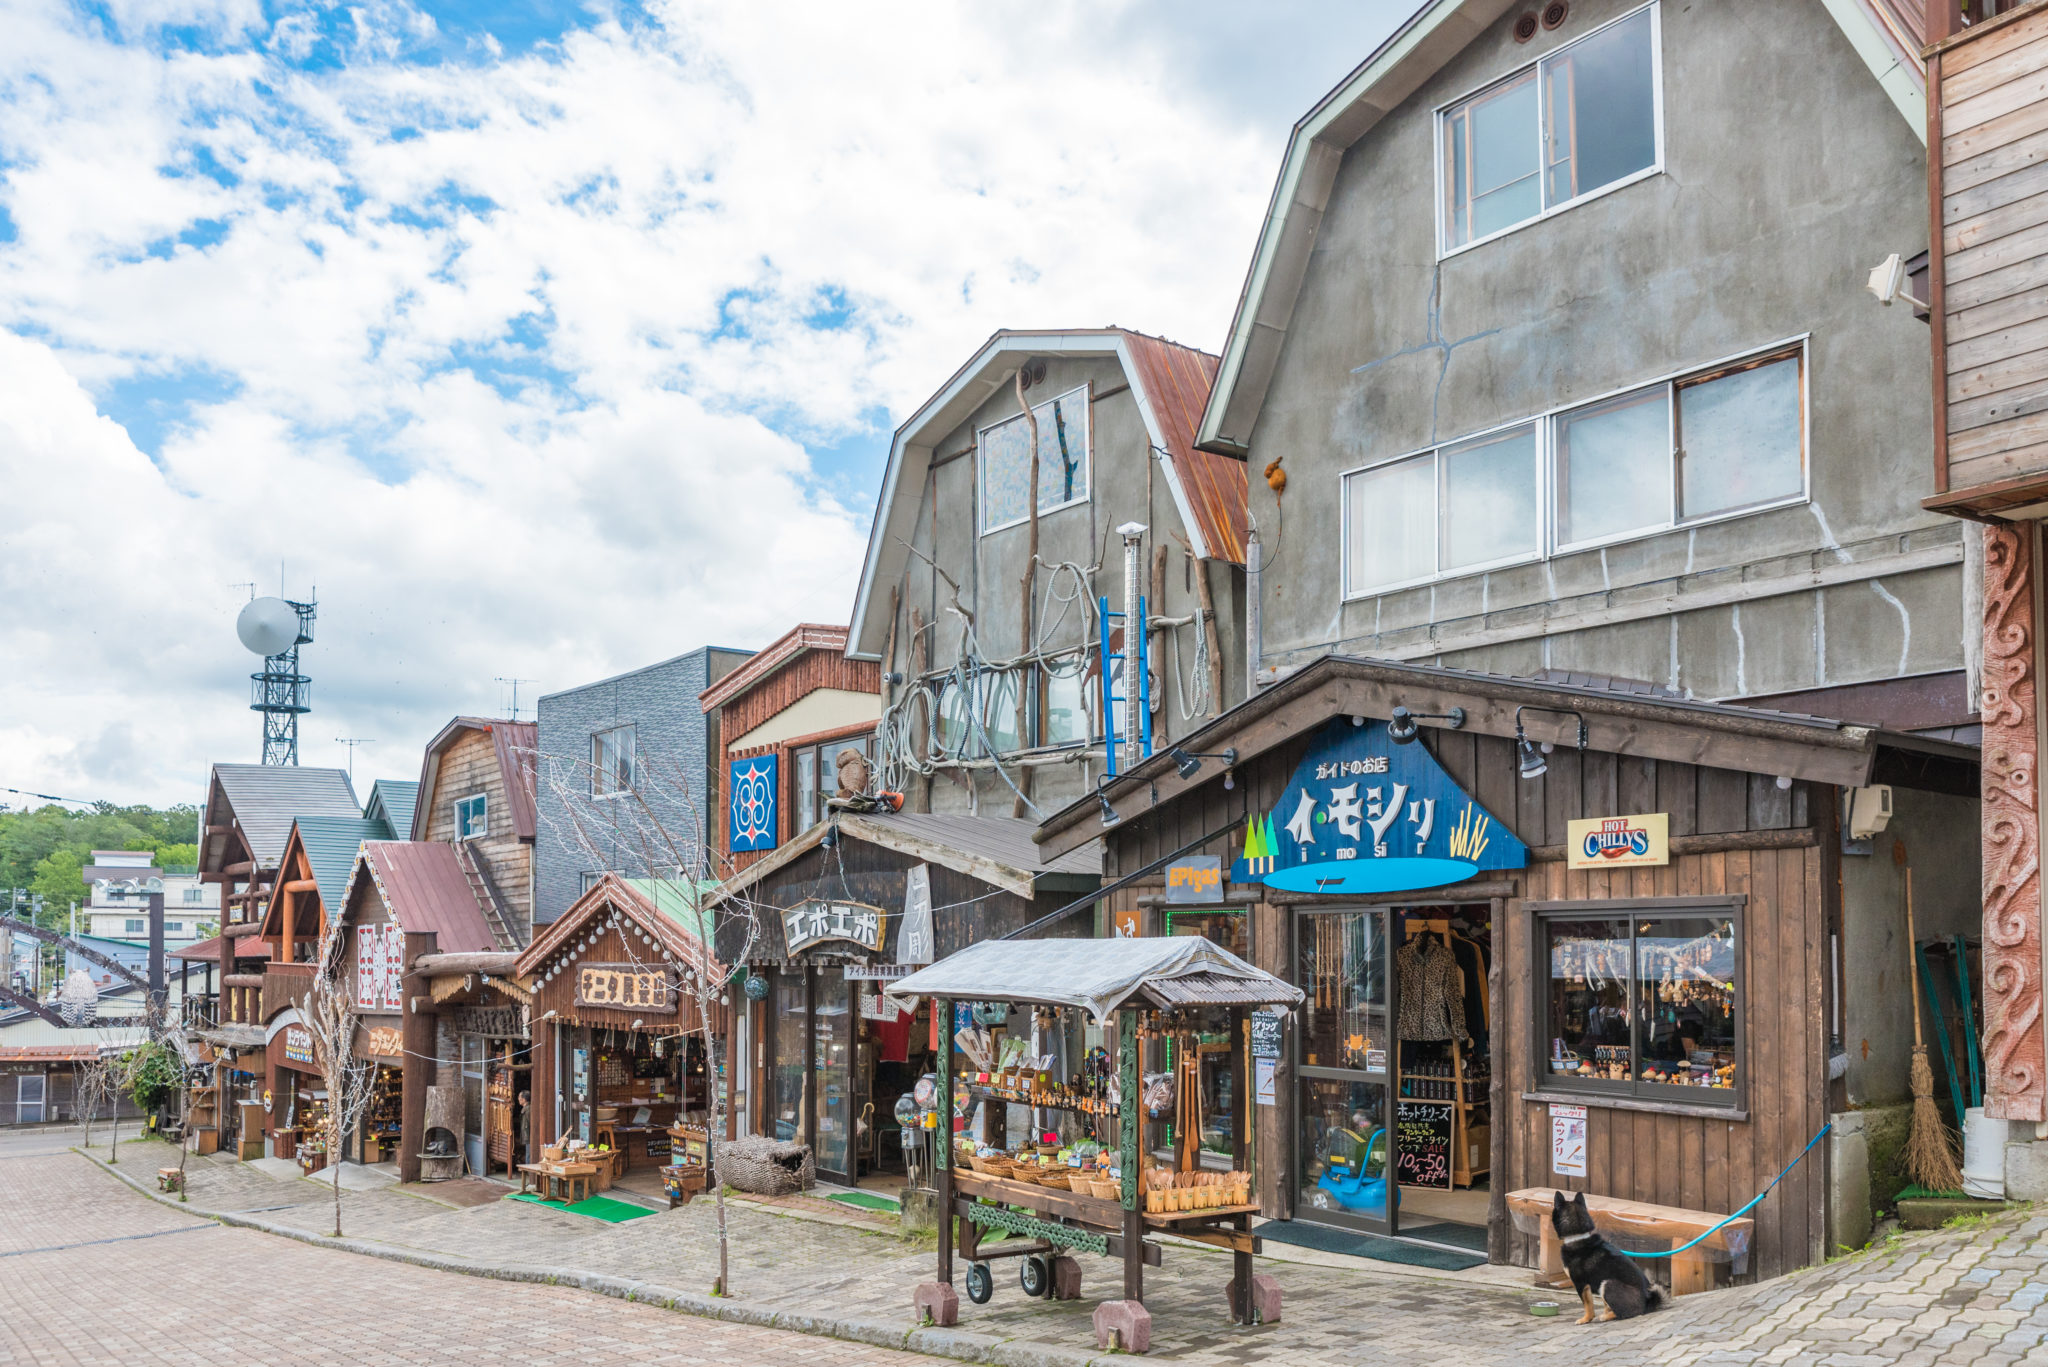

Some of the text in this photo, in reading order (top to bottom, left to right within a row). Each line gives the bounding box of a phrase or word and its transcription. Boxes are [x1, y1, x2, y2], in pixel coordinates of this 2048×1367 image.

[1315, 756, 1388, 780] ガイドのお店
[1604, 820, 1626, 832] HOT
[1585, 830, 1646, 856] CHILLYS
[1169, 866, 1219, 893] EPIgas
[786, 903, 878, 948] エポエポ
[1398, 1103, 1452, 1121] ホットチリーズ
[1422, 1144, 1446, 1153] SALE
[1555, 1119, 1565, 1156] ムックリ
